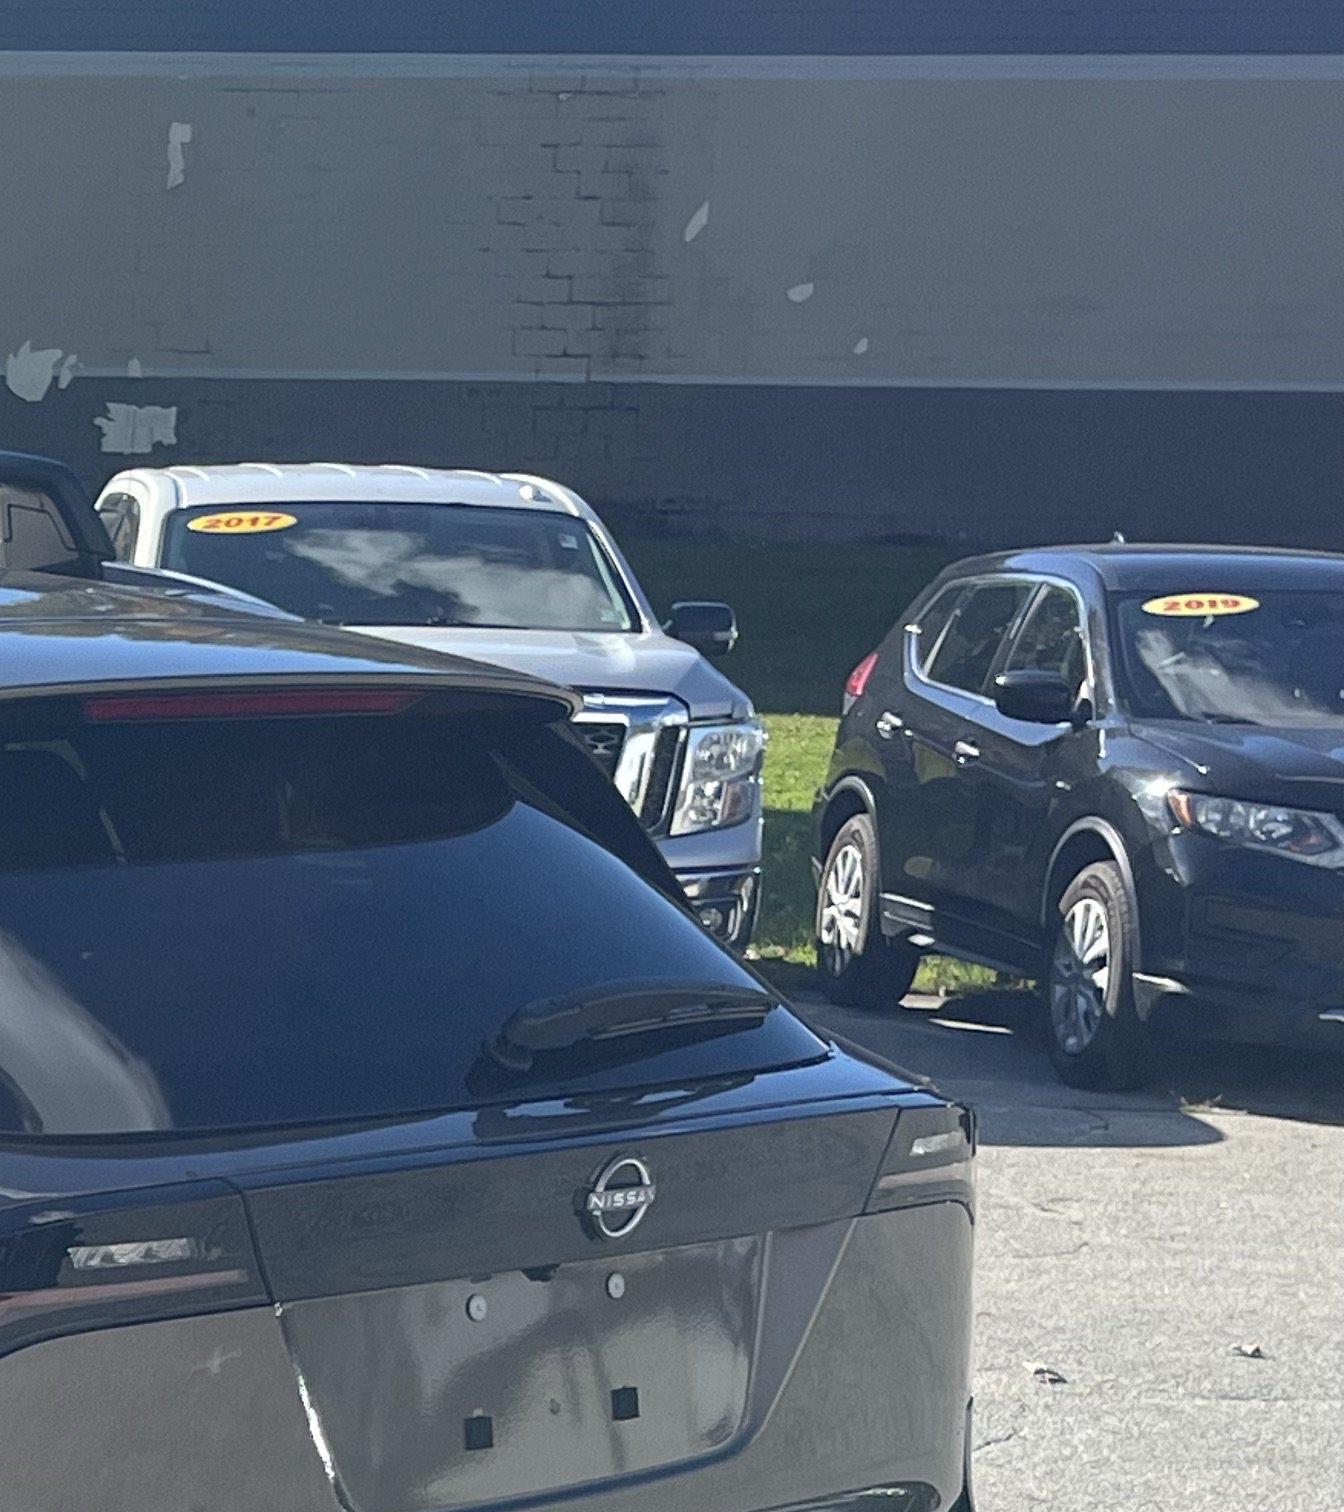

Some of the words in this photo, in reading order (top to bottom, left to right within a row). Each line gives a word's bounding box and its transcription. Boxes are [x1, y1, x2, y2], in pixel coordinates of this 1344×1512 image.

[201, 516, 283, 529] 2017
[1163, 599, 1241, 611] 2019
[589, 1187, 655, 1209] NISSAN
